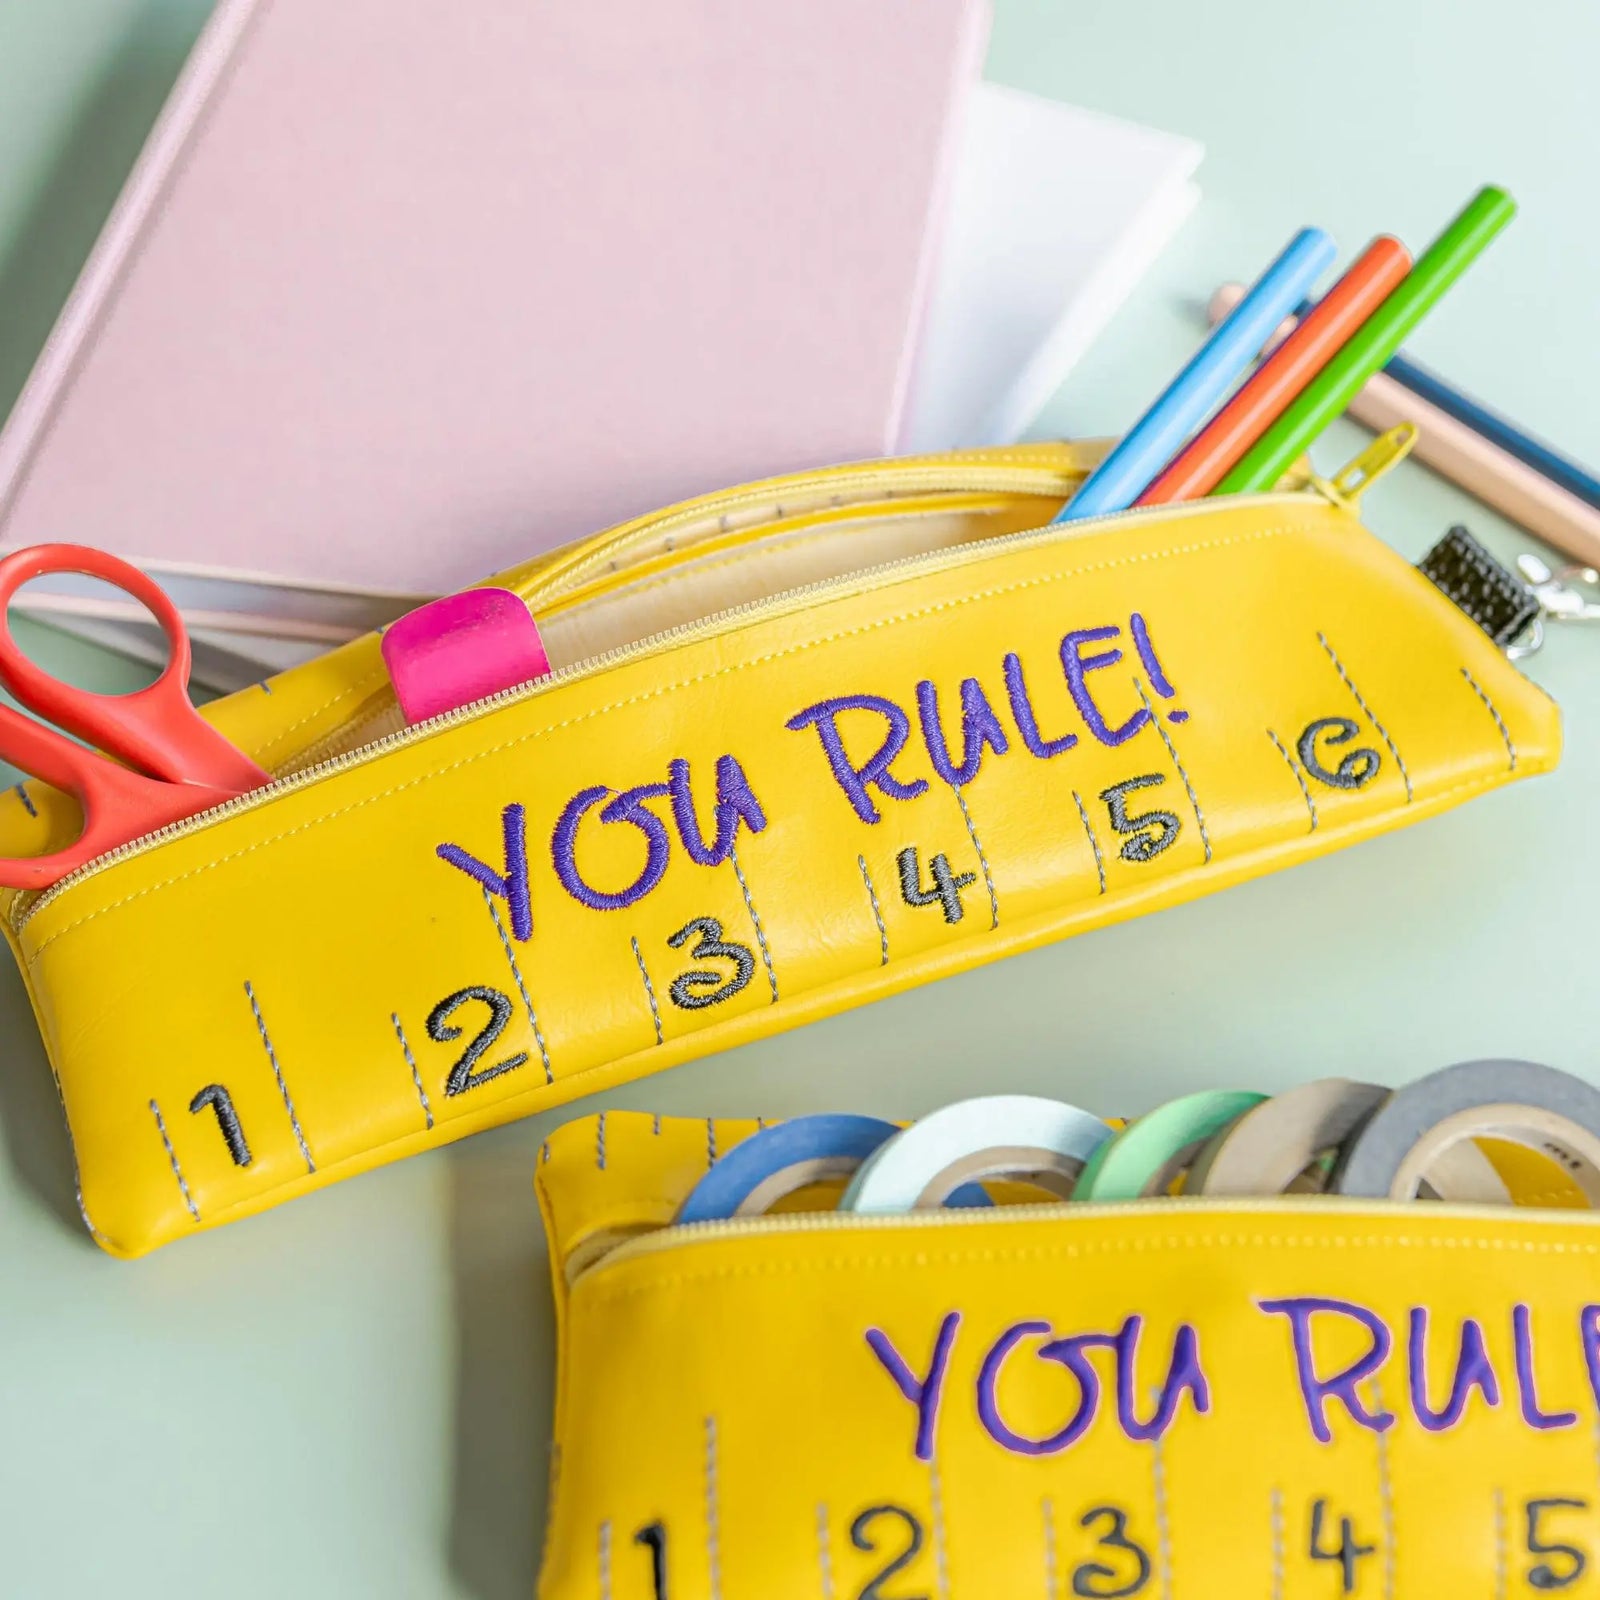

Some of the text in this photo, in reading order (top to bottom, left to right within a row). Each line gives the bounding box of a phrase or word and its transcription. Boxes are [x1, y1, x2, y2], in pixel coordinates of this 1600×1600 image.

[437, 613, 1190, 941] YOU RULE!
[189, 716, 1382, 1167] 1 2 3 4 5 6
[865, 1312, 1209, 1460] YOU
[634, 1499, 1588, 1600] 1 2 3 4 5
